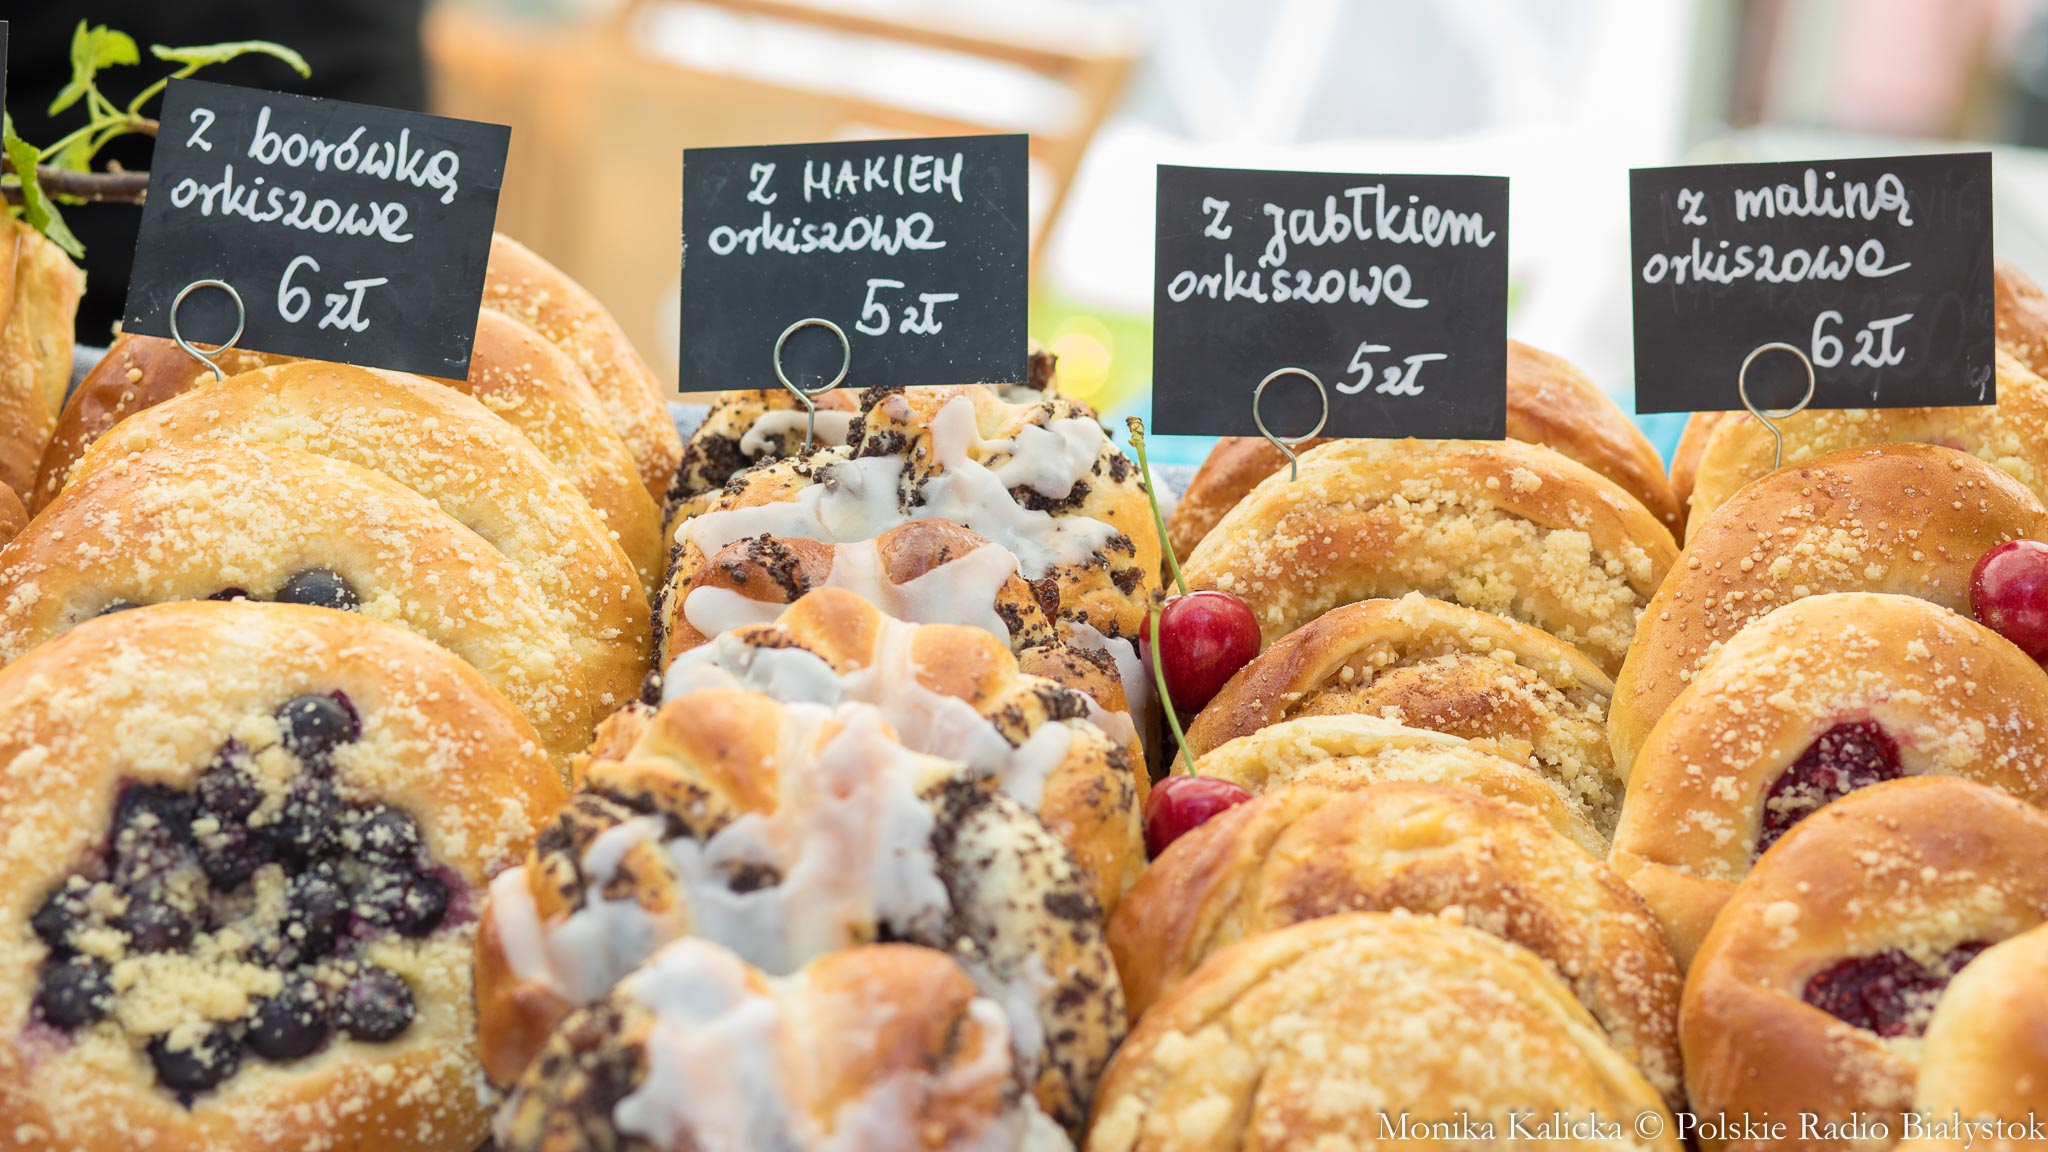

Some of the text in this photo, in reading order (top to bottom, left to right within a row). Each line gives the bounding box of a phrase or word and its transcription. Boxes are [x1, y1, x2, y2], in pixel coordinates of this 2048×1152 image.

[247, 105, 460, 205] borówką
[803, 152, 964, 203] MAKIEM
[170, 163, 414, 243] orkiszowe
[1257, 183, 1496, 269] jabłkiem
[1734, 168, 1914, 227] maliną
[708, 210, 947, 256] orkiszowe
[1642, 237, 1912, 285] orkiszowe
[277, 255, 389, 333] 6 zł
[854, 278, 960, 336] 5 zł
[1167, 252, 1429, 309] orkiszowe
[1335, 340, 1448, 396] 5 zł
[1811, 310, 1844, 368] 6
[1850, 313, 1914, 368] zł
